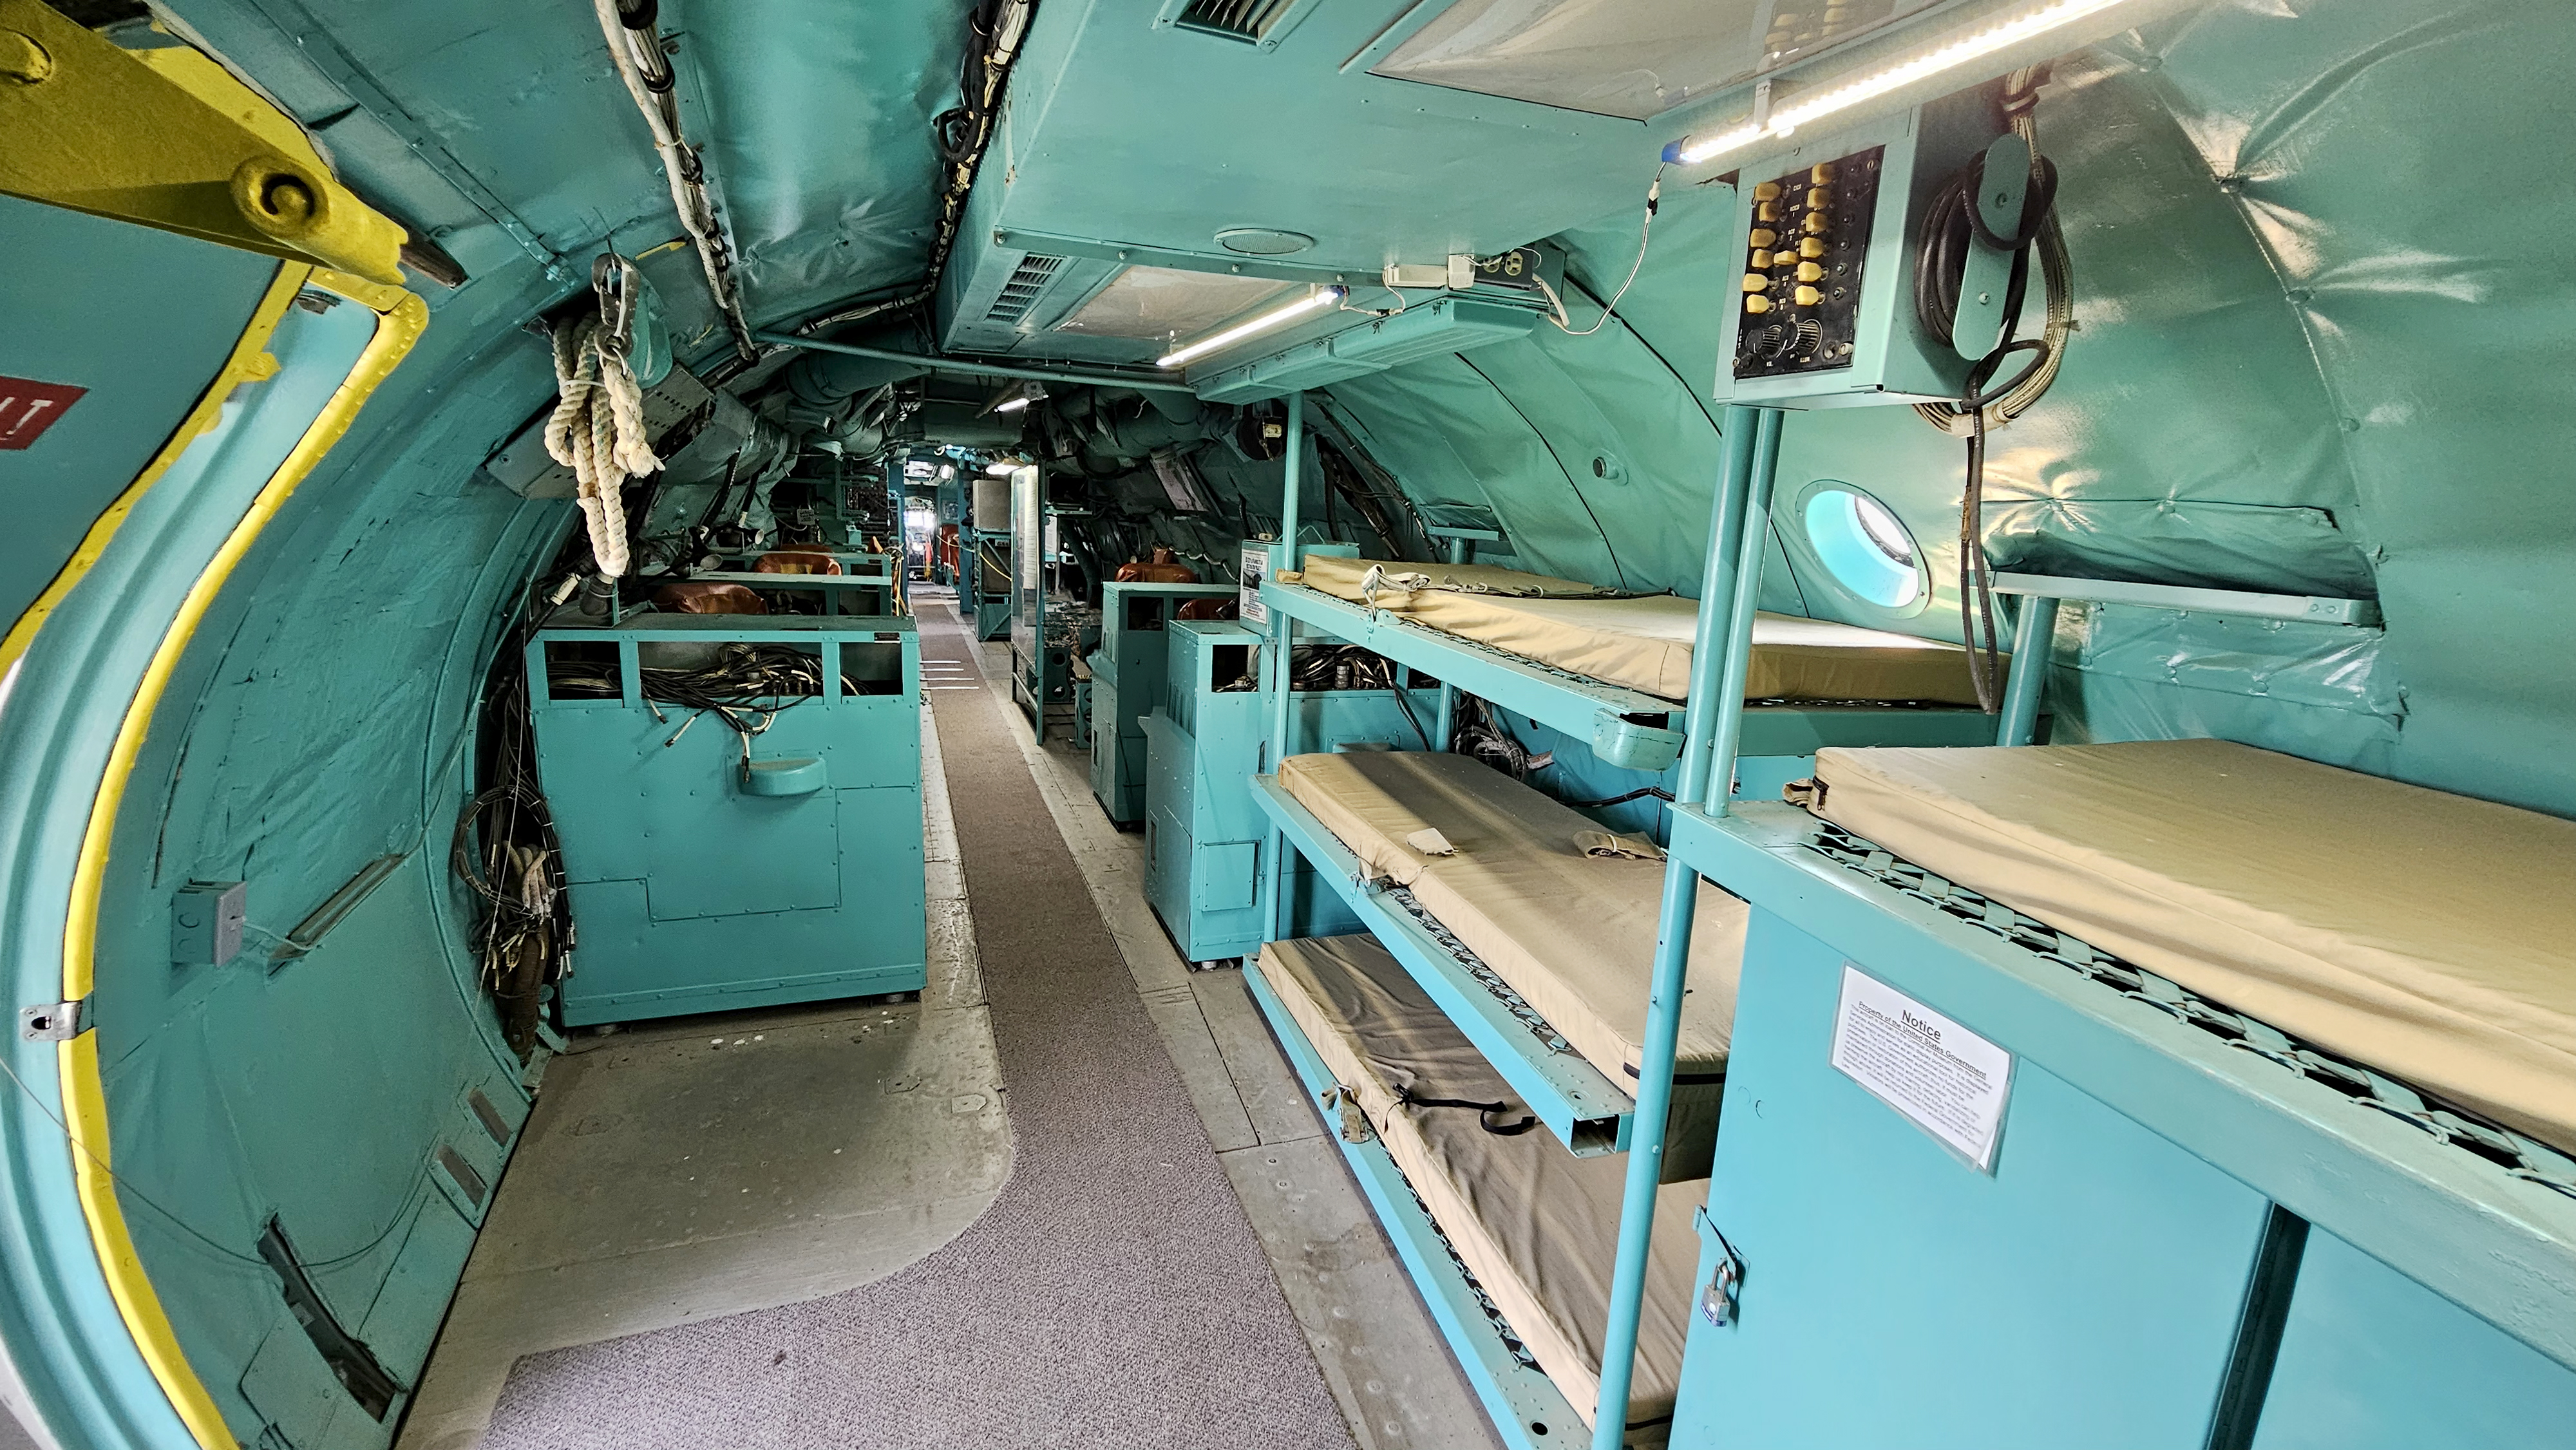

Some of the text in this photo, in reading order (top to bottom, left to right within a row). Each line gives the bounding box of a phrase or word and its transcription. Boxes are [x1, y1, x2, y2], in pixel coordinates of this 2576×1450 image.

[1859, 1000, 1883, 1020] Property
[1892, 1019, 1901, 1029] the
[1903, 1025, 1922, 1041] United
[1924, 1037, 1944, 1053] States
[1945, 1050, 1987, 1078] Government
[1902, 1009, 1942, 1040] Notice
